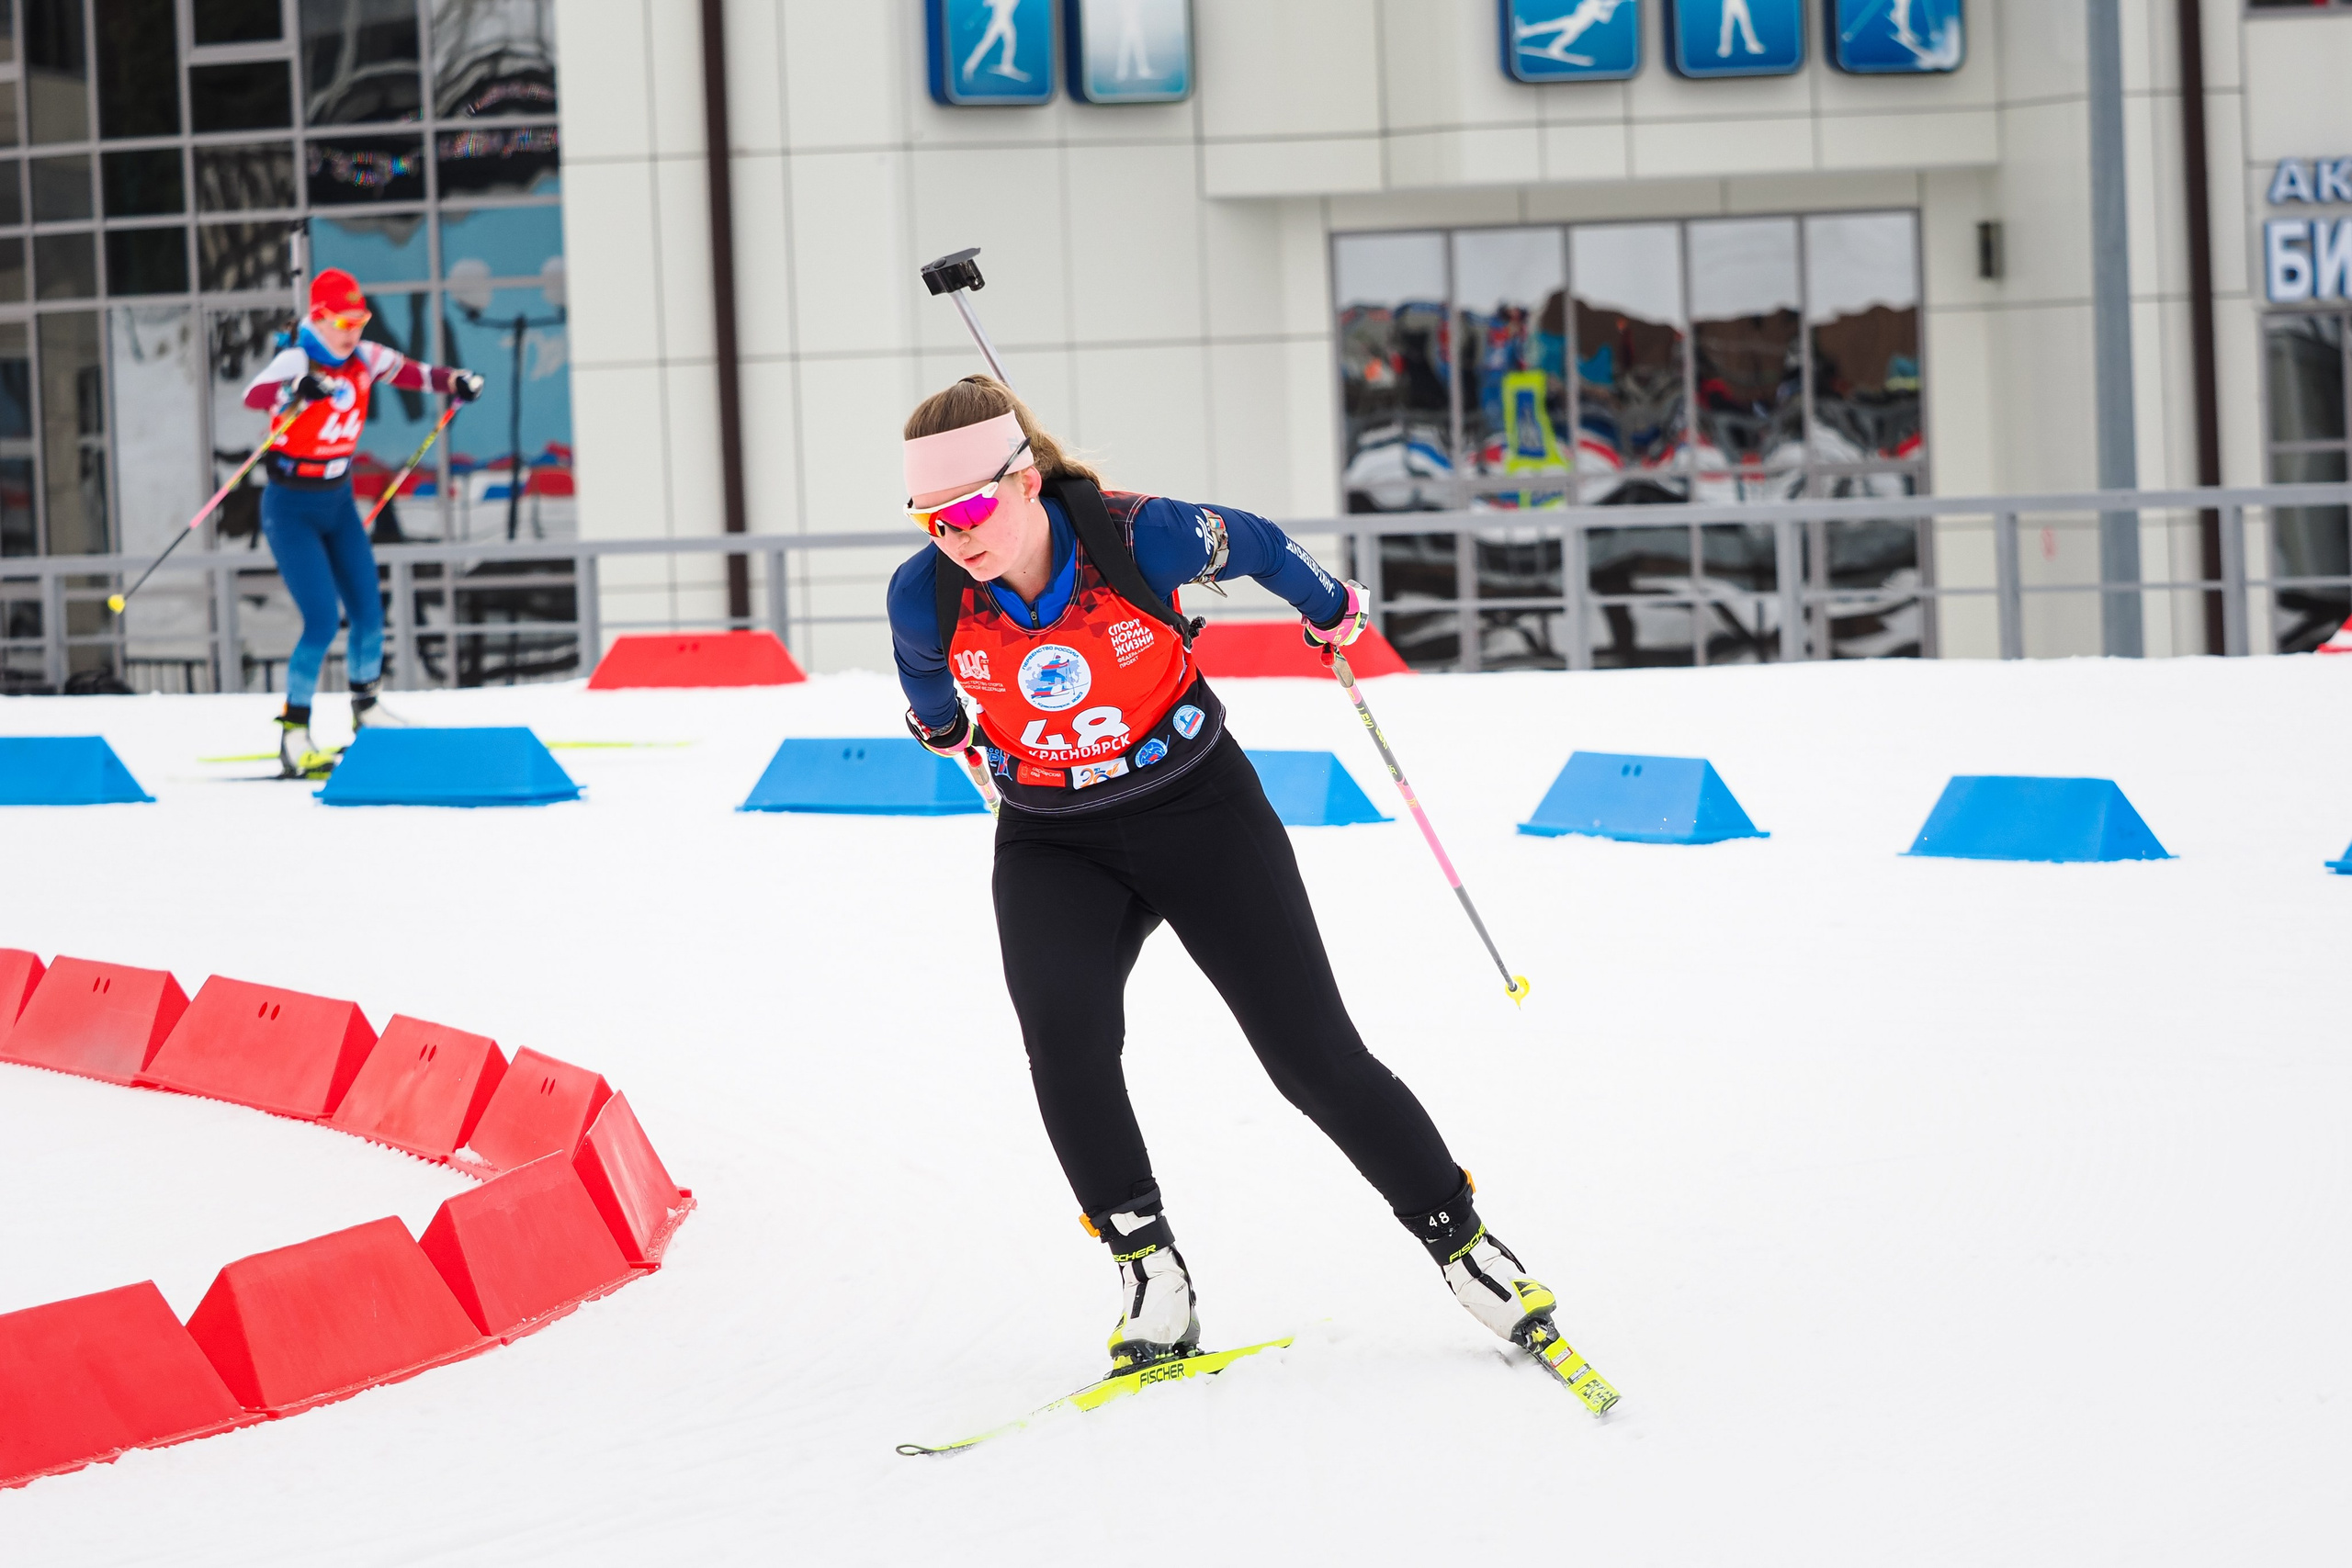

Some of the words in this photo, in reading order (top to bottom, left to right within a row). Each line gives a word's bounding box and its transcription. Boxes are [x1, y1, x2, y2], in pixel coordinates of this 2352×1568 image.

[318, 407, 363, 445] 44
[1108, 617, 1140, 637] СПОРТ
[1111, 626, 1151, 648] НОРМА
[1114, 631, 1154, 658] ЖИЗНИ
[1022, 646, 1054, 671] ПЕРВЕНСТВО
[1054, 646, 1080, 659] РОССИИ
[1119, 655, 1138, 669] ПРОЕКТ
[1020, 705, 1131, 750] 48
[1429, 1212, 1450, 1227] 48
[1139, 1362, 1185, 1389] FISCHER
